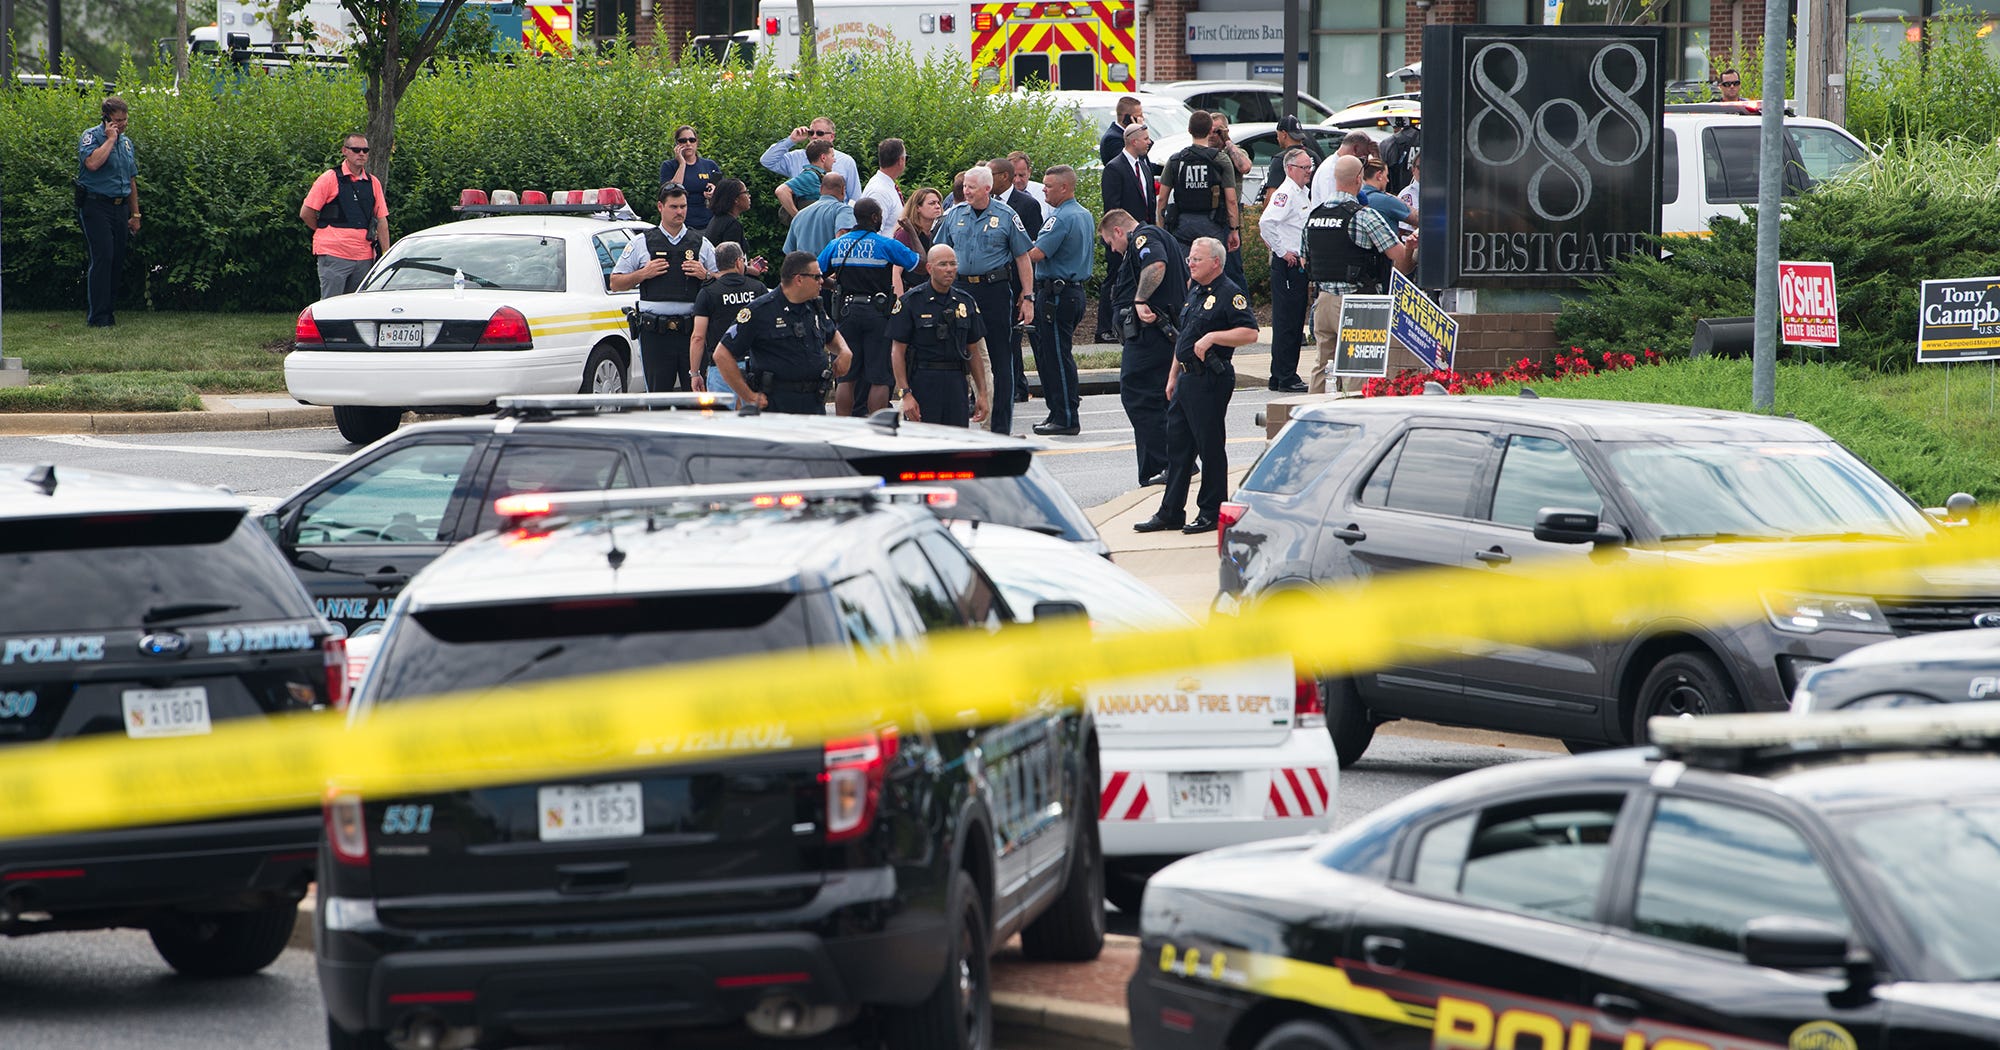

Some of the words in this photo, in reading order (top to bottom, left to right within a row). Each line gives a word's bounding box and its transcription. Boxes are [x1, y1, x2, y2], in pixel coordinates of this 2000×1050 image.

[1197, 26, 1217, 40] First
[1219, 25, 1260, 41] Citizens
[1262, 25, 1283, 40] Ban
[1185, 165, 1208, 182] ATF
[1185, 181, 1208, 189] POLICE
[1307, 217, 1343, 228] POLICE
[837, 250, 875, 259] POLICE
[722, 291, 755, 305] POLICE
[1782, 267, 1835, 317] O'SHEA
[1941, 287, 1986, 307] Tony
[1403, 283, 1455, 332] SHERIFF
[1401, 293, 1453, 353] BATEMAN
[1786, 324, 1805, 337] STATE
[1806, 324, 1836, 338] DELEGATE
[392, 329, 421, 342] 84760
[1341, 328, 1388, 343] FREDERICKS
[1354, 344, 1386, 359] SHERIFF
[243, 624, 315, 651] PATROL
[2, 636, 106, 665] POLICE
[0, 690, 38, 719] 30
[1098, 694, 1190, 714] ANNAPOLIS
[1197, 695, 1230, 712] FIRE
[162, 702, 204, 727] 1807
[381, 804, 434, 834] 531
[586, 798, 638, 825] 1853
